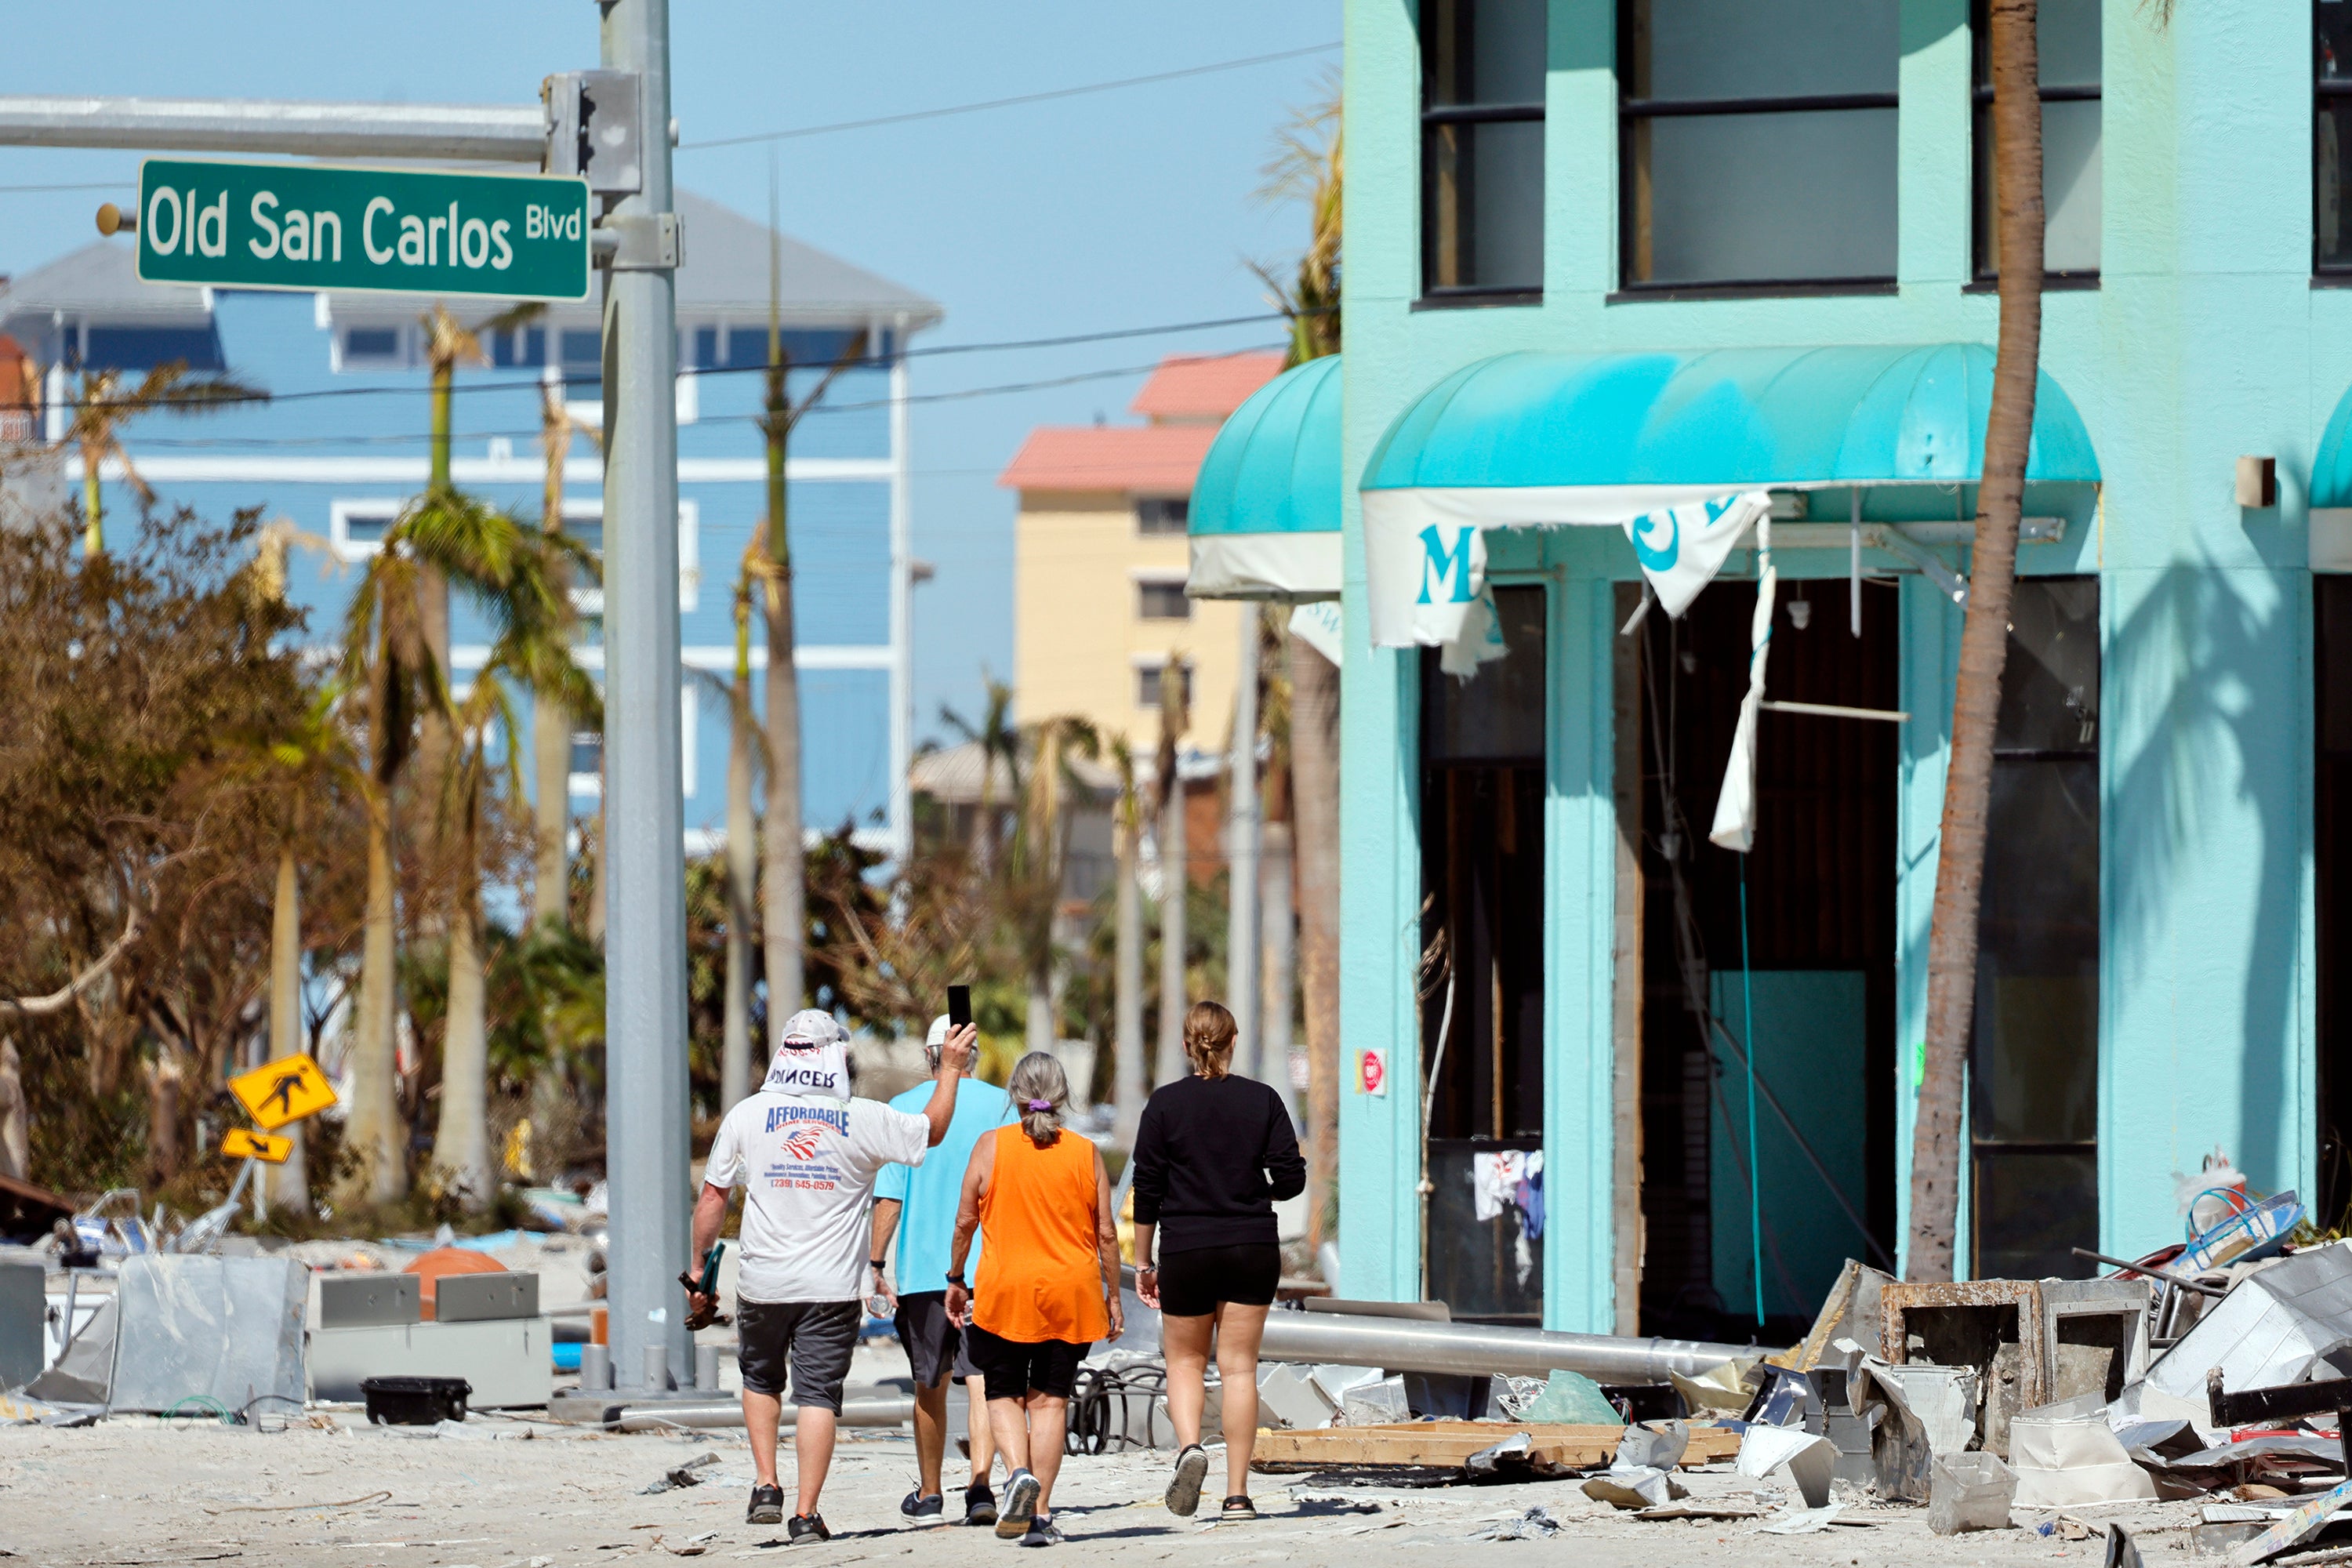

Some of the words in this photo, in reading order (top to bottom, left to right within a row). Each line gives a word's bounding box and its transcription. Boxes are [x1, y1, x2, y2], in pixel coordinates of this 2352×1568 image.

[147, 186, 228, 258] Old
[248, 191, 342, 262] San
[362, 196, 514, 270] Carlos
[526, 204, 581, 241] Blvd
[765, 1106, 849, 1138] AFFORDABLE
[775, 1119, 800, 1131] HOME
[802, 1119, 842, 1135] SERVICES
[771, 1179, 793, 1189] (239)
[795, 1179, 834, 1191] 645-0579
